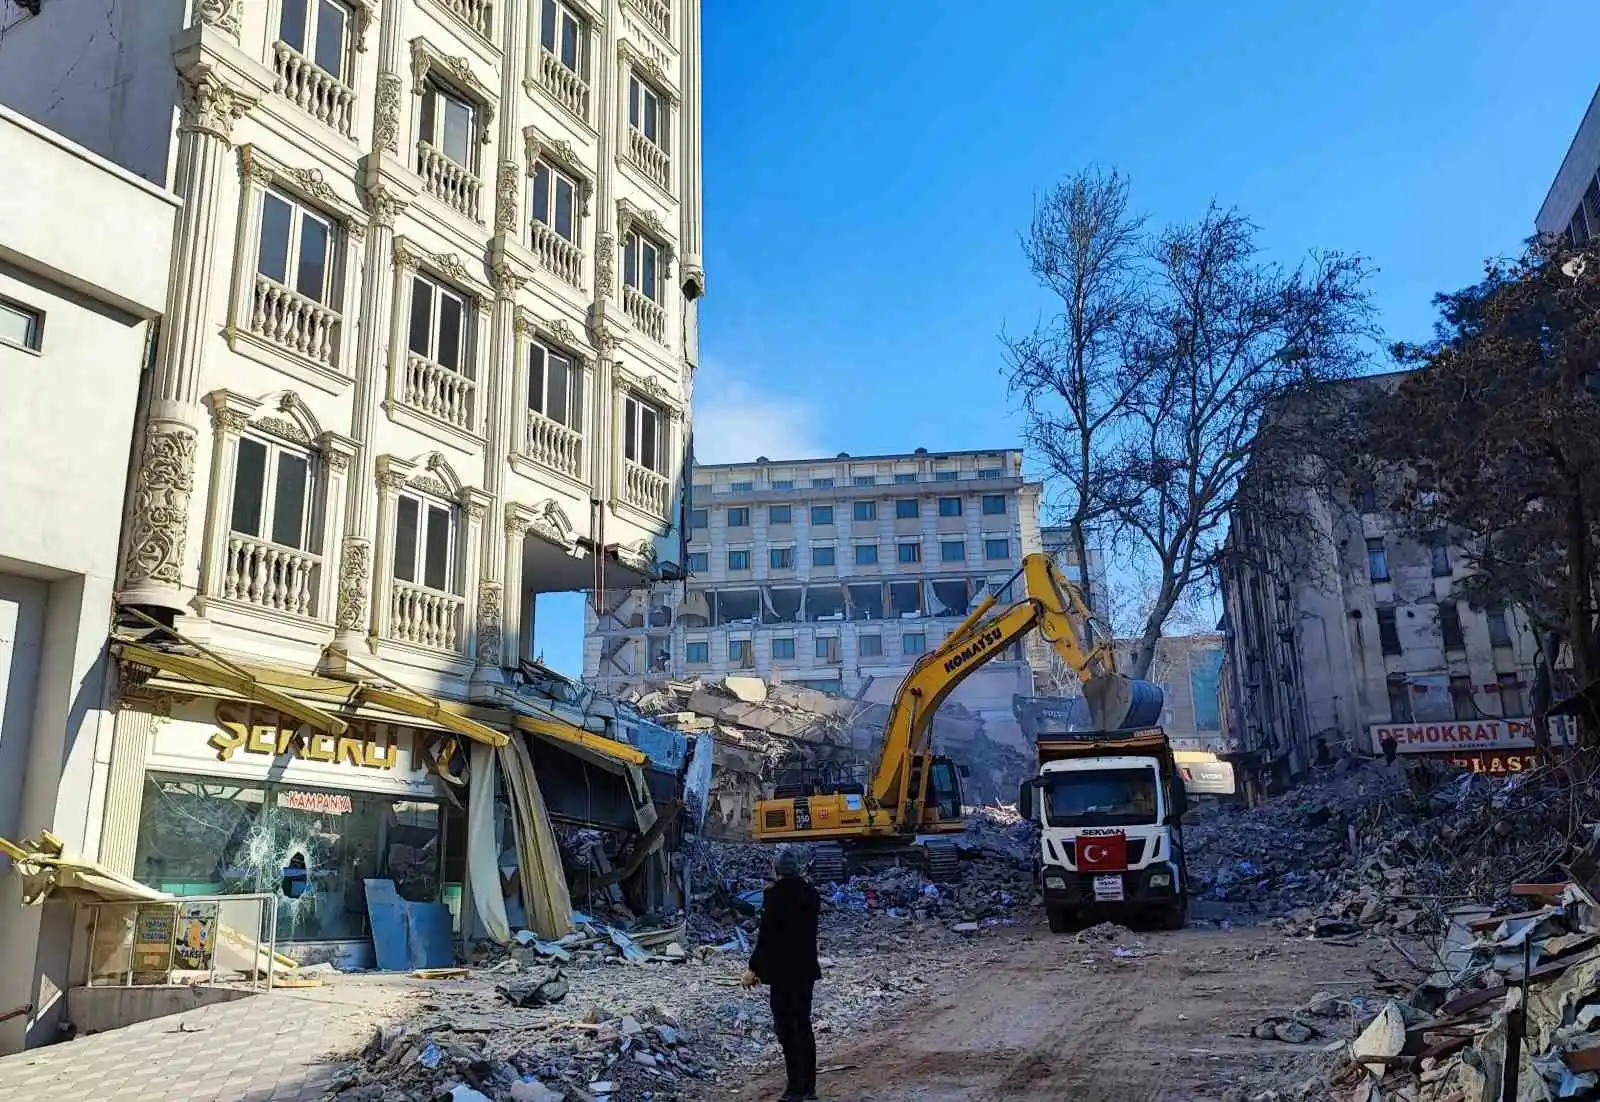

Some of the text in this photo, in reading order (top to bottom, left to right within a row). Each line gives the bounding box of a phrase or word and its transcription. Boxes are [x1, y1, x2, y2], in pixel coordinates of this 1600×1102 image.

[944, 627, 1002, 673] KOMATSU
[1377, 722, 1500, 745] DEMOKRAT
[287, 791, 352, 813] KAMPANYA
